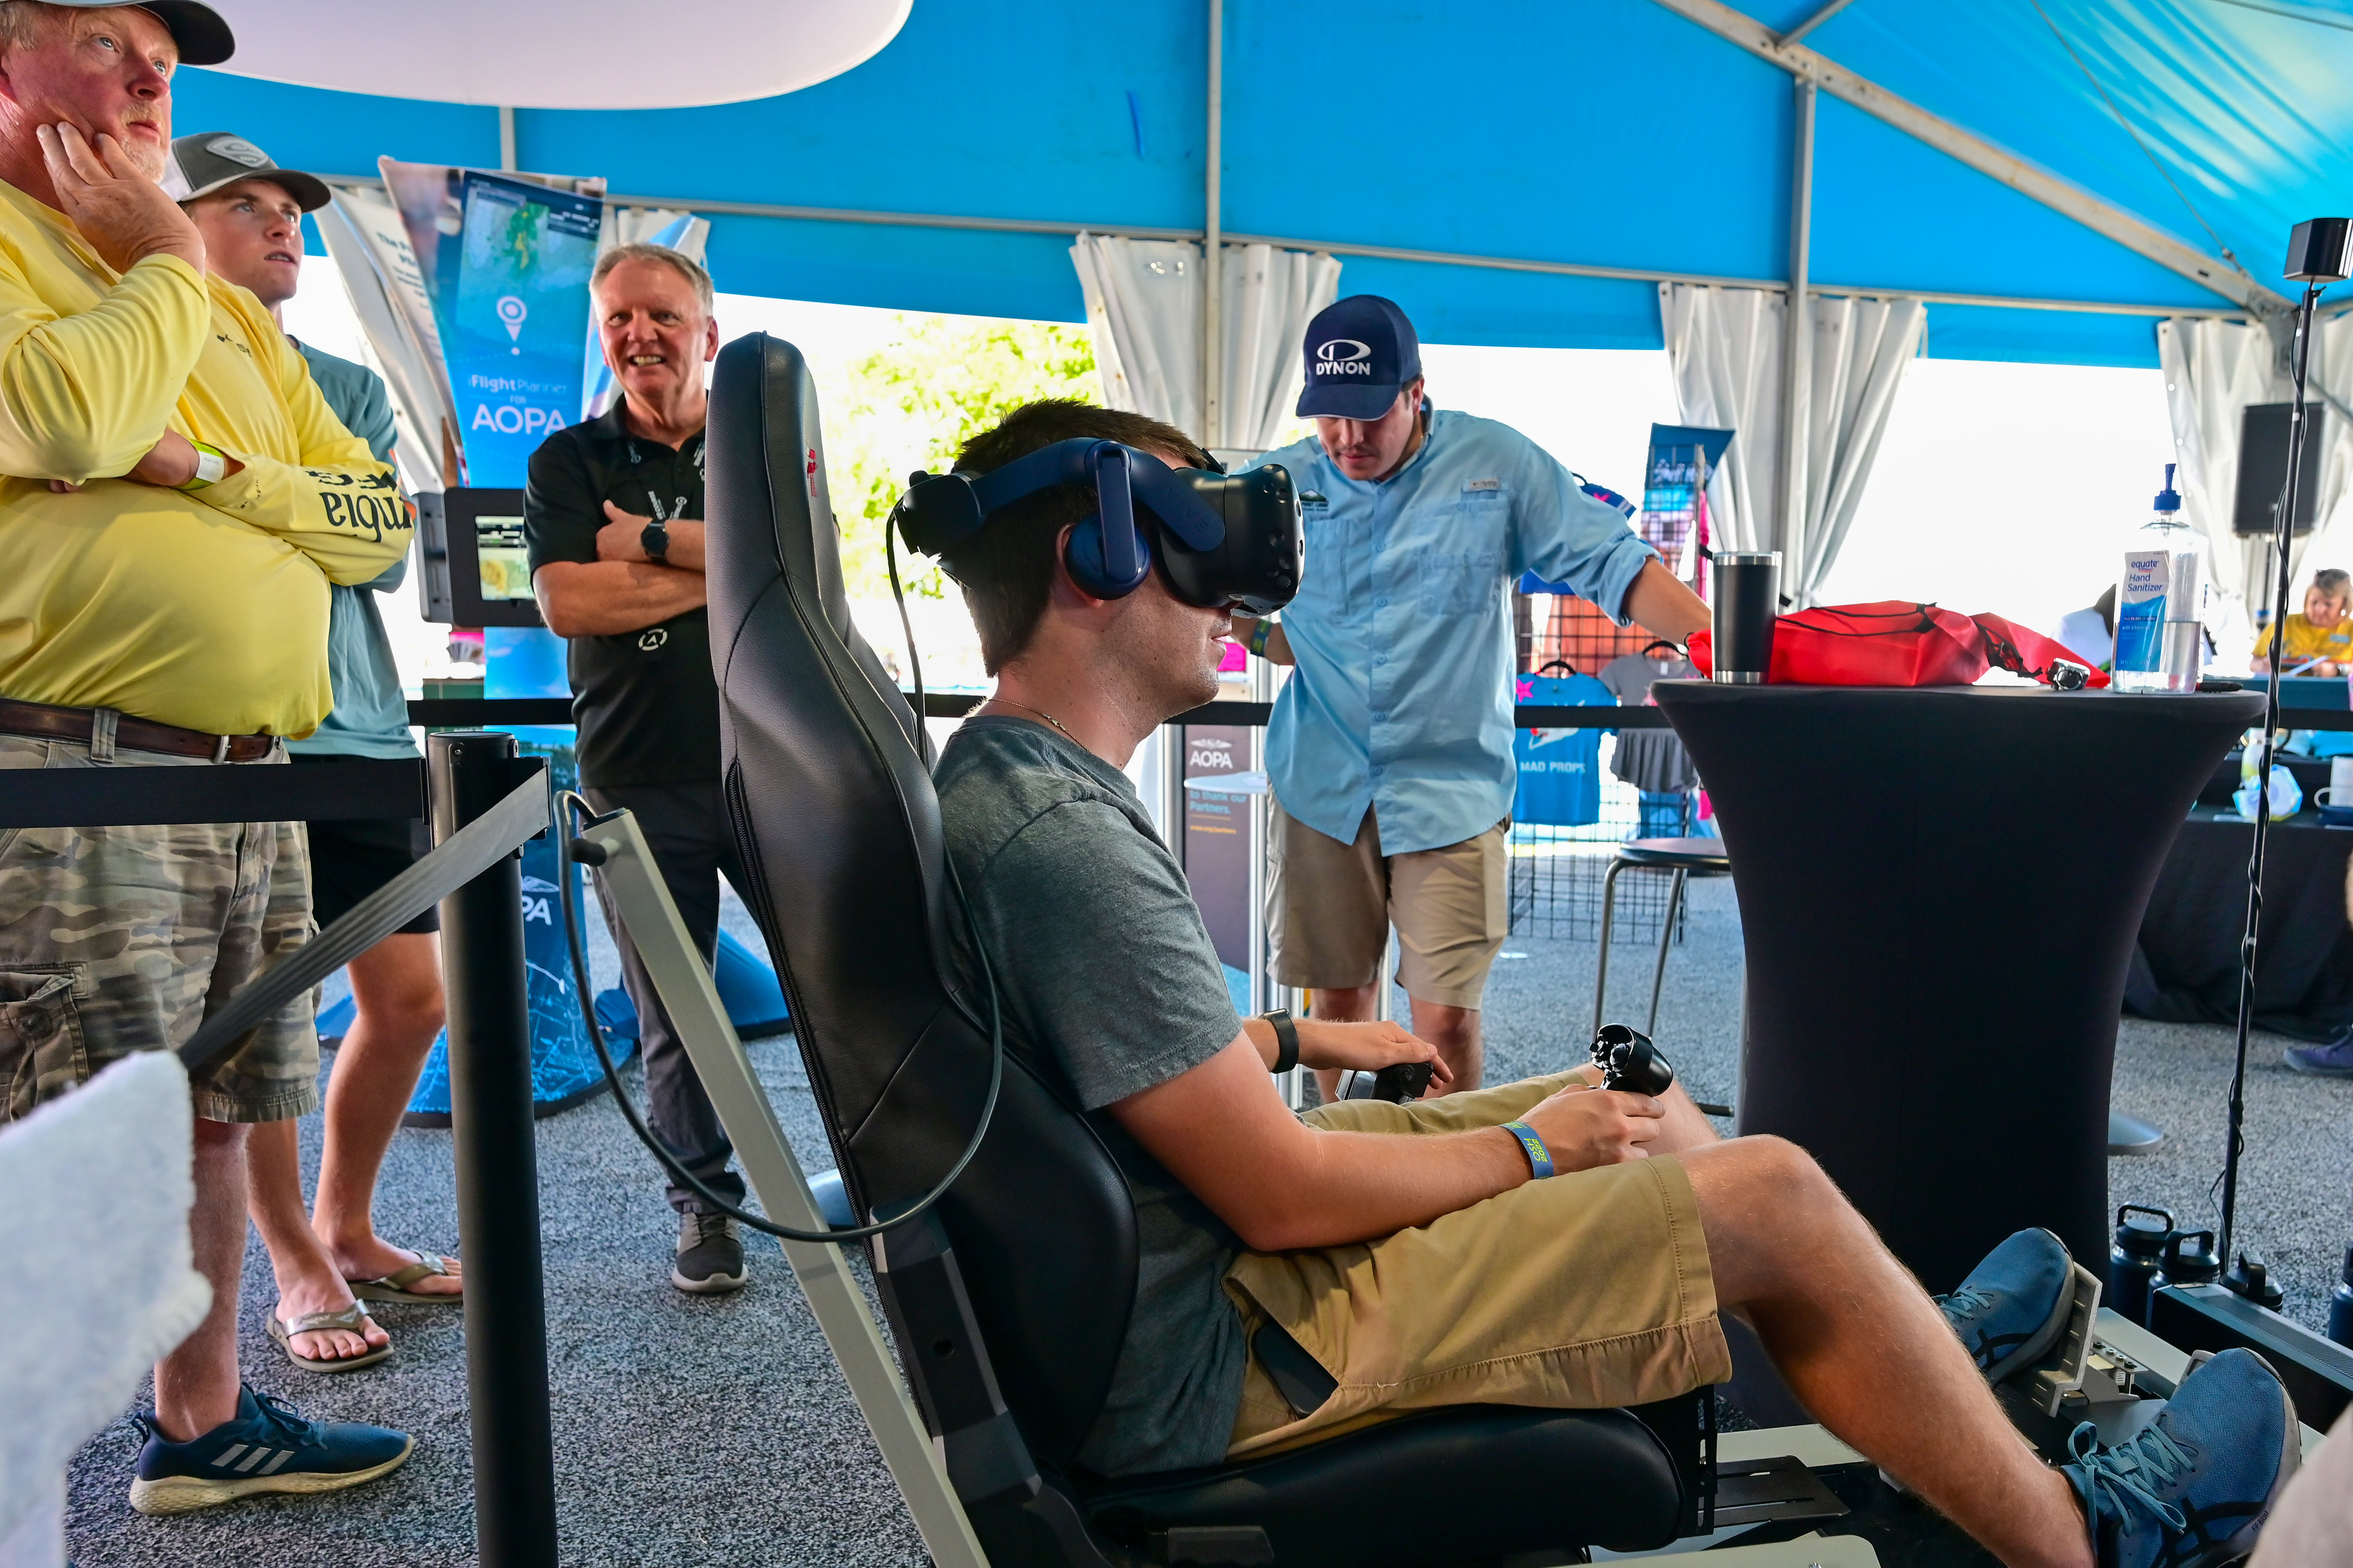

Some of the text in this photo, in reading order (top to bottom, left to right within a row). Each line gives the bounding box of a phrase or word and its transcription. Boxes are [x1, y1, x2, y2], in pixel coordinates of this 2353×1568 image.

[1315, 361, 1371, 376] DYNON
[472, 403, 567, 436] AOPA
[2131, 559, 2158, 570] equate
[2129, 573, 2151, 582] Hand
[2127, 583, 2163, 592] Sanitizer
[1189, 750, 1233, 769] AOPA
[1520, 761, 1586, 773] MAD PROPS
[1189, 800, 1231, 814] Partners.
[522, 895, 552, 926] PA
[1524, 1138, 1541, 1162] OSH
[1531, 1139, 1548, 1162] 2022
[2251, 1522, 2259, 1532] FF
